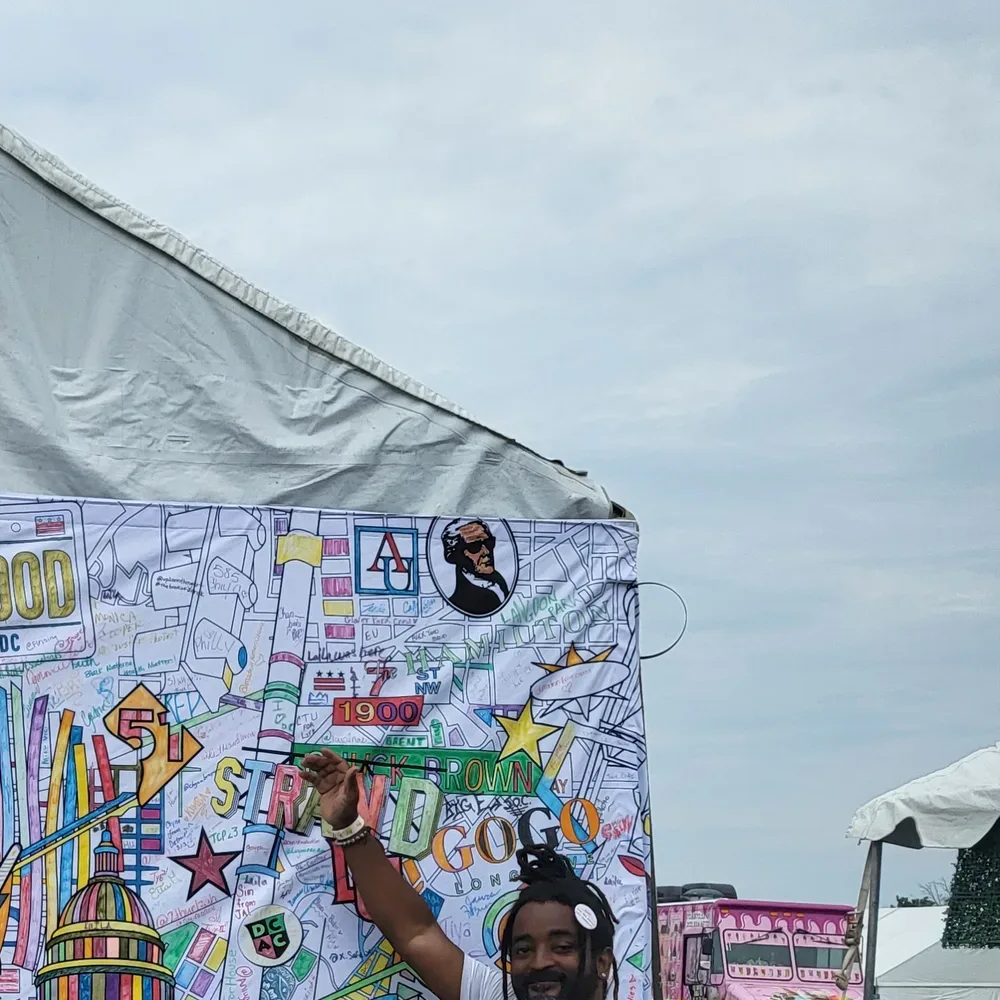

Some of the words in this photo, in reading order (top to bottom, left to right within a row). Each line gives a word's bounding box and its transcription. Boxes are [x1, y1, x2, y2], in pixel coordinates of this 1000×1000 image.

[0, 633, 21, 652] DC
[404, 600, 613, 675] HAMILTON
[416, 666, 441, 681] ST
[414, 681, 442, 695] NW
[338, 700, 419, 723] 1900
[424, 756, 533, 793] BROWN
